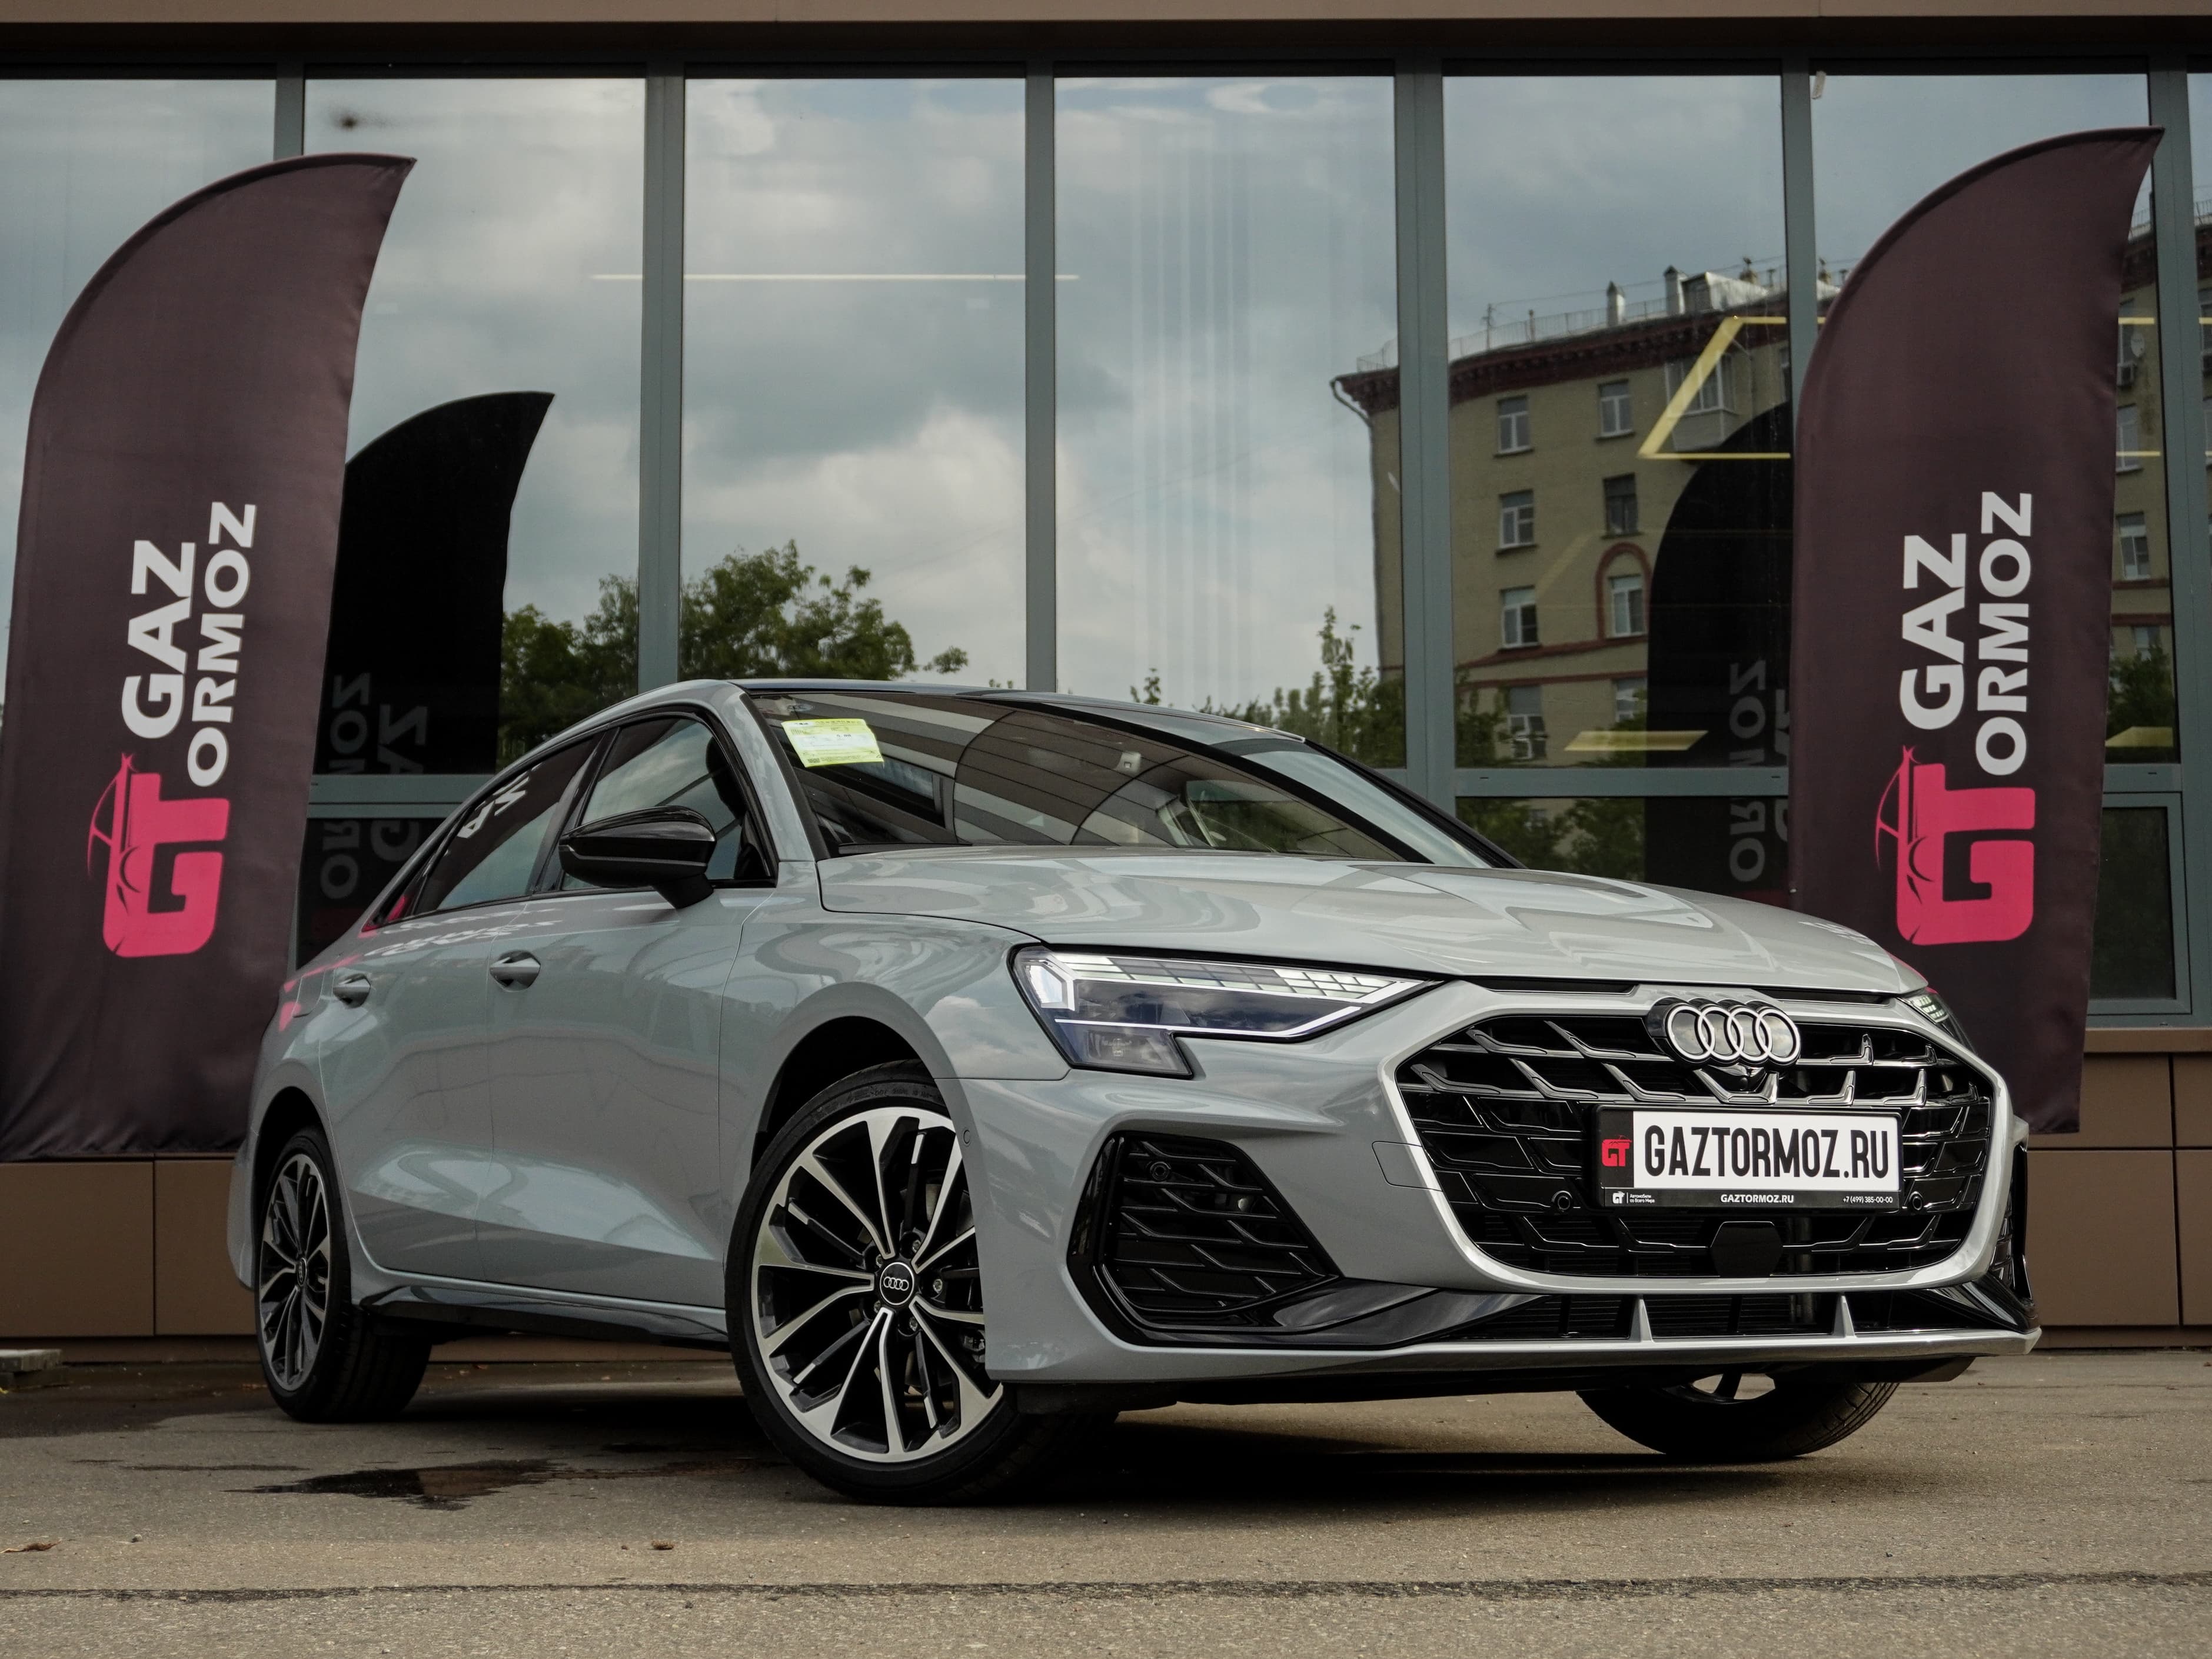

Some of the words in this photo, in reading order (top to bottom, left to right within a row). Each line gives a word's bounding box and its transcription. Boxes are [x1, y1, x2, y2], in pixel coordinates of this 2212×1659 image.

[122, 540, 195, 739] GAZ
[188, 501, 257, 787] ORMOZ
[1900, 533, 1967, 730] GAZ
[1975, 491, 2032, 776] ORMOZ
[1602, 1138, 1632, 1167] GT
[1645, 1125, 1889, 1179] GAZTORMOZ.RU
[1720, 1193, 1794, 1203] GAZTORMOZ.RU
